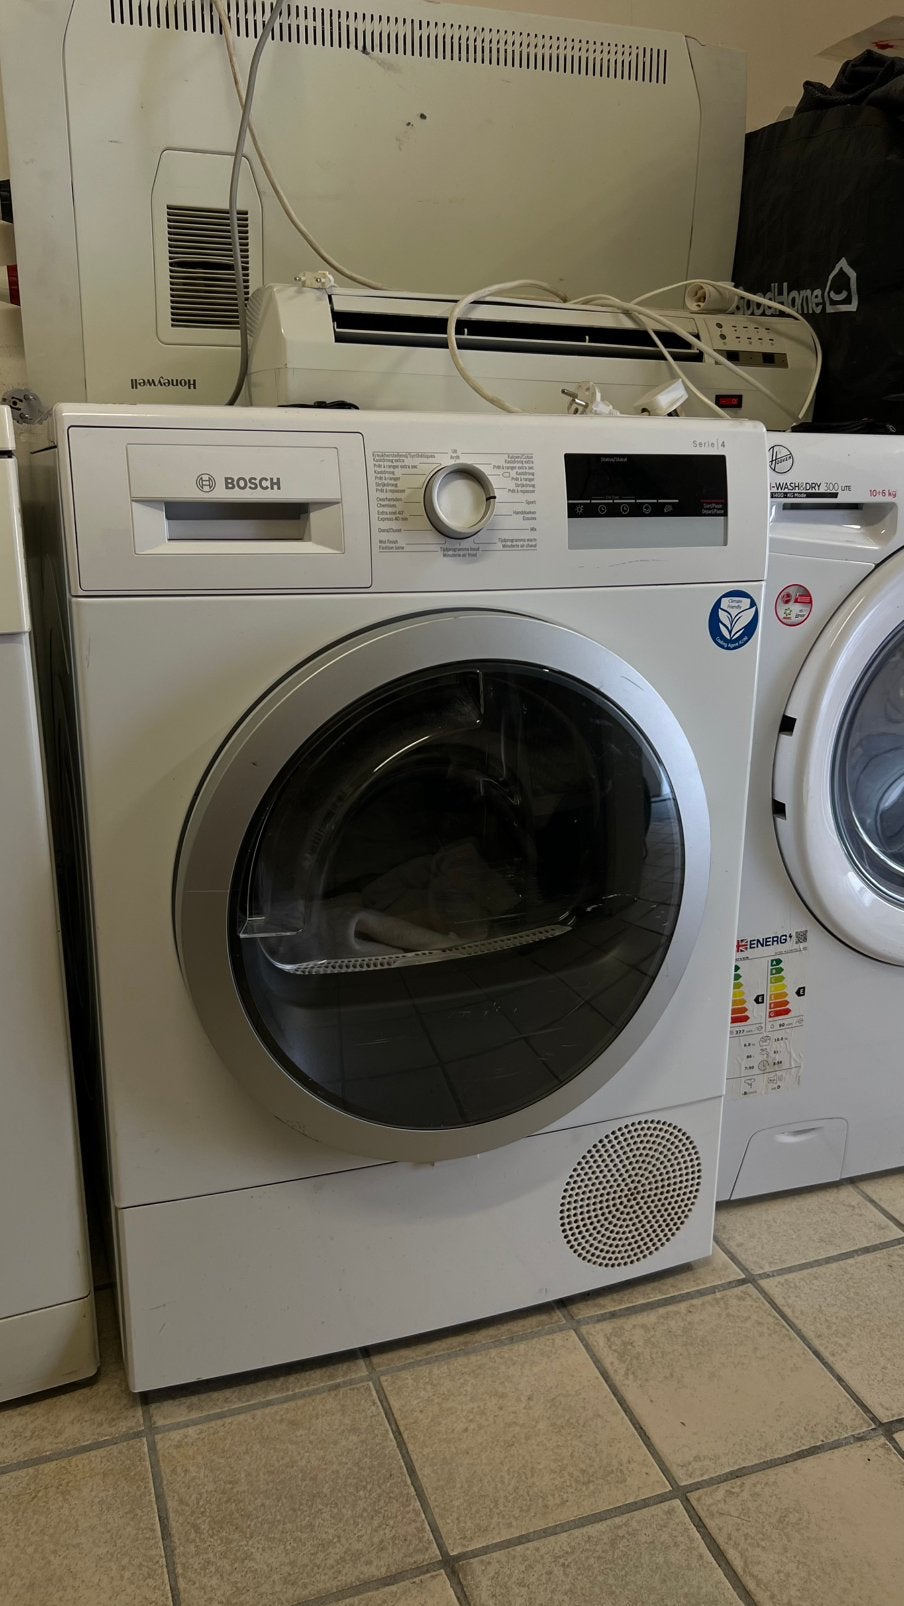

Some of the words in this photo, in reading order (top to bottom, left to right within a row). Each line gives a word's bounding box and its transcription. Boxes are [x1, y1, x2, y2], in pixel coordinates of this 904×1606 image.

[130, 376, 197, 390] Honeywell
[692, 440, 715, 448] Serie
[720, 440, 726, 448] 4
[224, 476, 281, 490] BOSCH
[824, 482, 839, 491] 300
[888, 489, 897, 498] kg
[749, 934, 787, 949] ENERG
